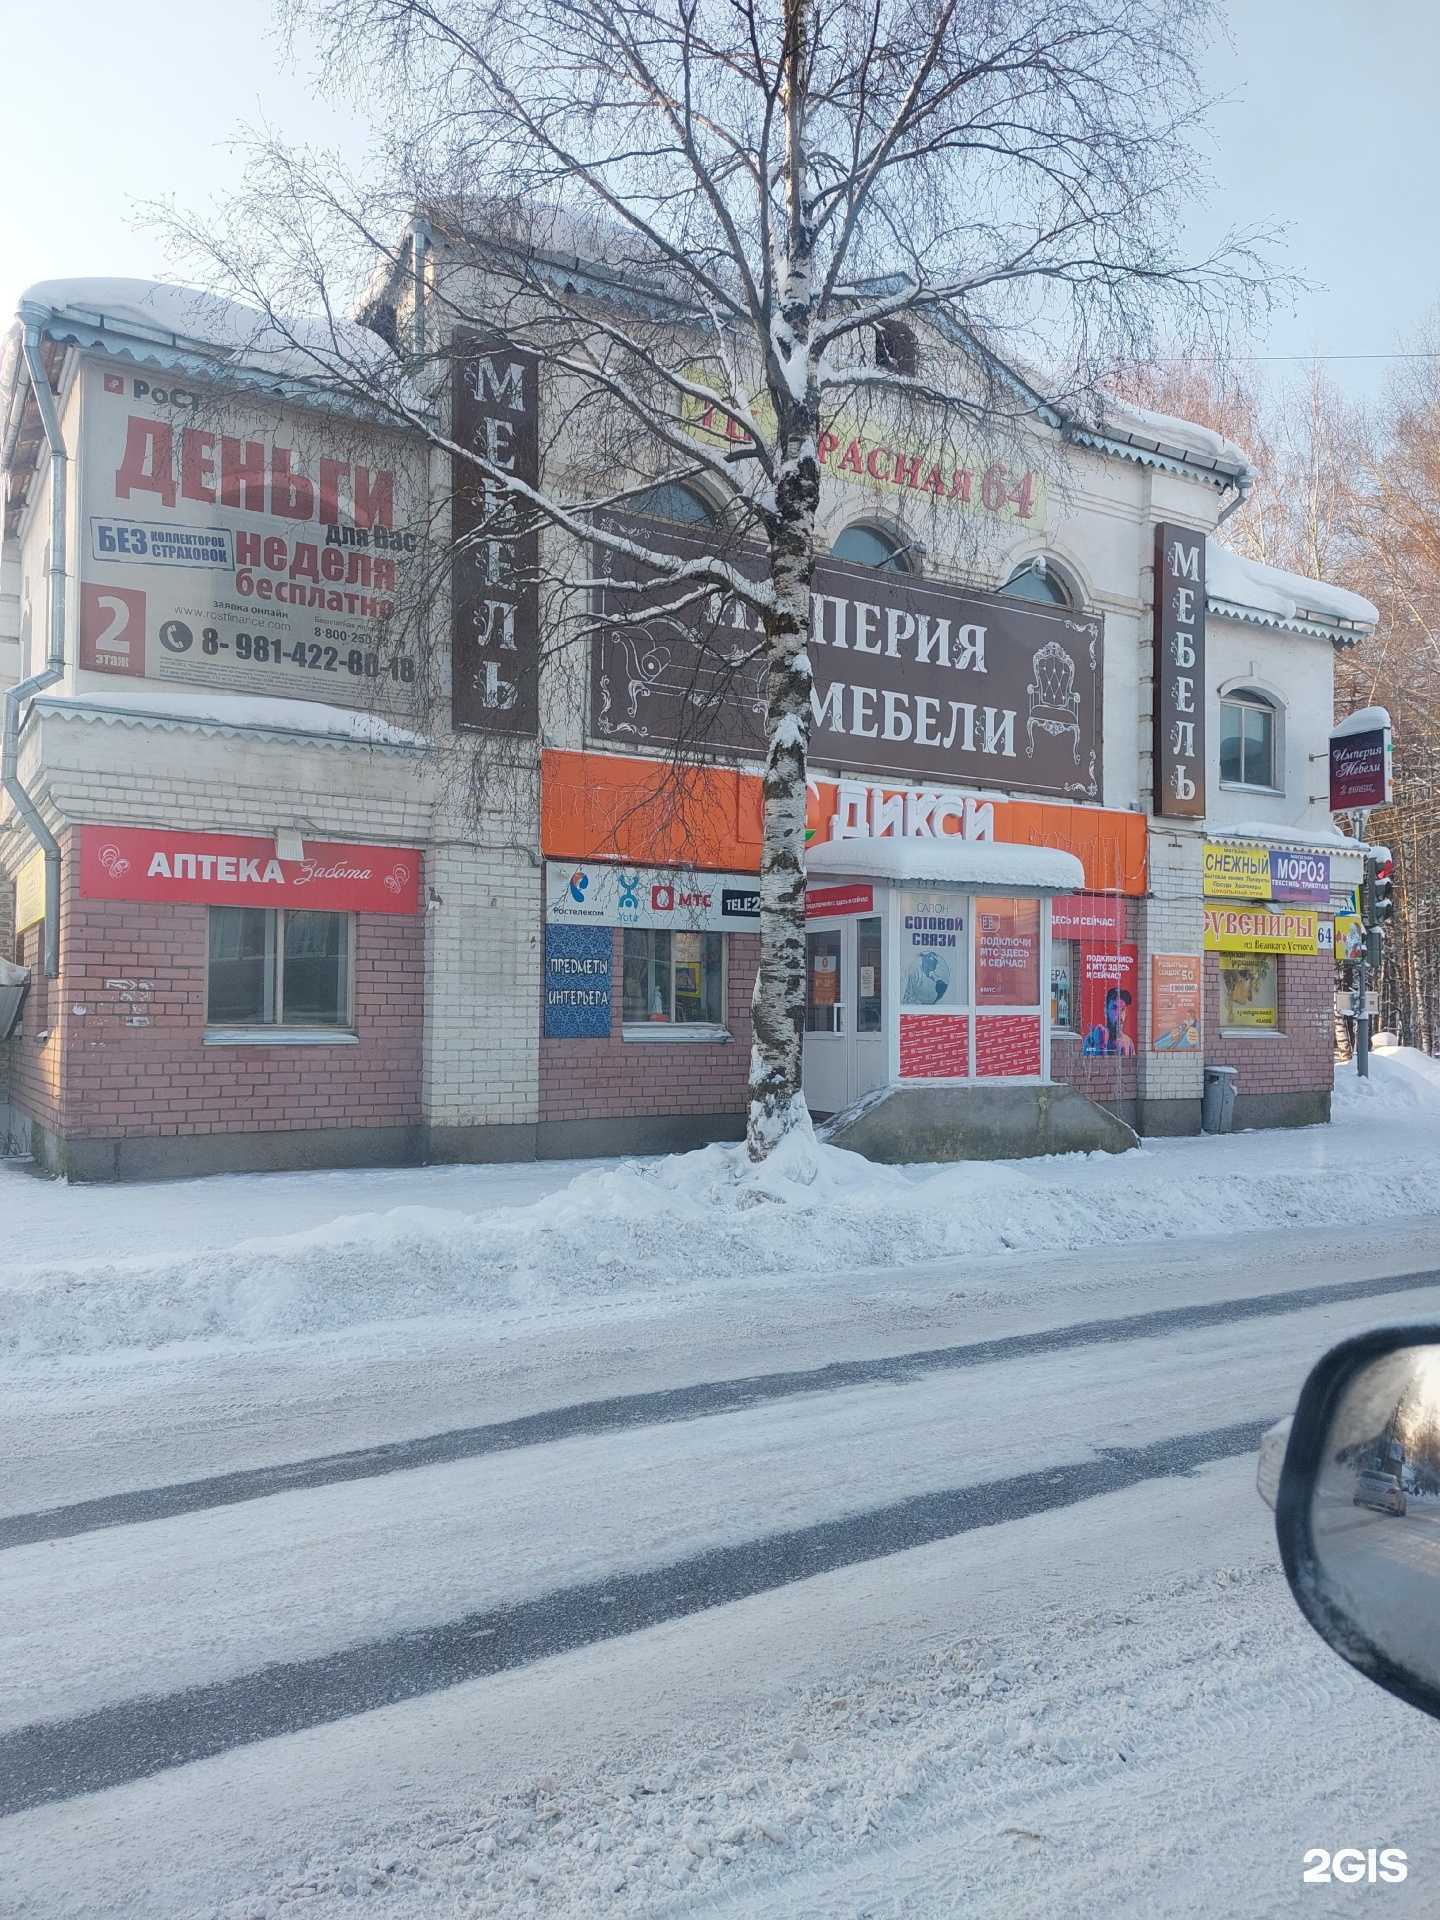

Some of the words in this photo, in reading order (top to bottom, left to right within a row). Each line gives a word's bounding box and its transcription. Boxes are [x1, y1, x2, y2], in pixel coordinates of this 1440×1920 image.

[115, 415, 395, 529] ДЕНЬГИ
[816, 425, 973, 503] РАСНАЯ
[981, 461, 1036, 520] 64
[98, 525, 149, 555] БЕЗ
[150, 530, 226, 548] КОЛЛЕКТОРОВ
[325, 524, 369, 547] для
[151, 544, 228, 563] СТРАХОВОК
[235, 530, 396, 593] неделя
[235, 567, 395, 618] бесплатно
[95, 595, 131, 653] 2
[704, 586, 988, 674] ИПЕРИЯ
[1170, 541, 1200, 801] МЕБЕЛЬ
[809, 679, 1017, 758] МЕБЕЛИ
[1332, 746, 1382, 762] Империя
[1336, 760, 1381, 778] Мебели
[830, 783, 994, 841] ДИКСИ
[147, 851, 286, 885] АПТЕКА
[293, 857, 374, 886] Забота
[1205, 852, 1269, 875] СНЕЖНЫЙ
[1277, 858, 1325, 882] МОРОЗ
[679, 893, 712, 908] МТС
[726, 895, 760, 912] TELE2
[917, 902, 949, 914] САЛОН
[905, 915, 963, 932] СОТОВОЙ
[1050, 915, 1072, 925] ДЕСЬ
[1073, 917, 1079, 925] И
[1080, 916, 1116, 927] СЕЙЧАС!
[912, 932, 957, 948] СВЯЗИ
[980, 936, 1032, 947] ПОДКЛЮЧИ
[1317, 927, 1332, 944] 64
[980, 948, 1000, 957] МТС
[1001, 948, 1030, 958] ЗДЕСЬ
[1255, 939, 1286, 951] Великого
[550, 958, 609, 975] ПРЕДМЕТЫ
[980, 959, 987, 967] И
[988, 957, 1027, 968] СЕЙЧАС!
[1092, 963, 1107, 971] МТС
[1107, 963, 1130, 972] ЗДЕСЬ
[548, 990, 609, 1006] ИНТЕРЬЕРА
